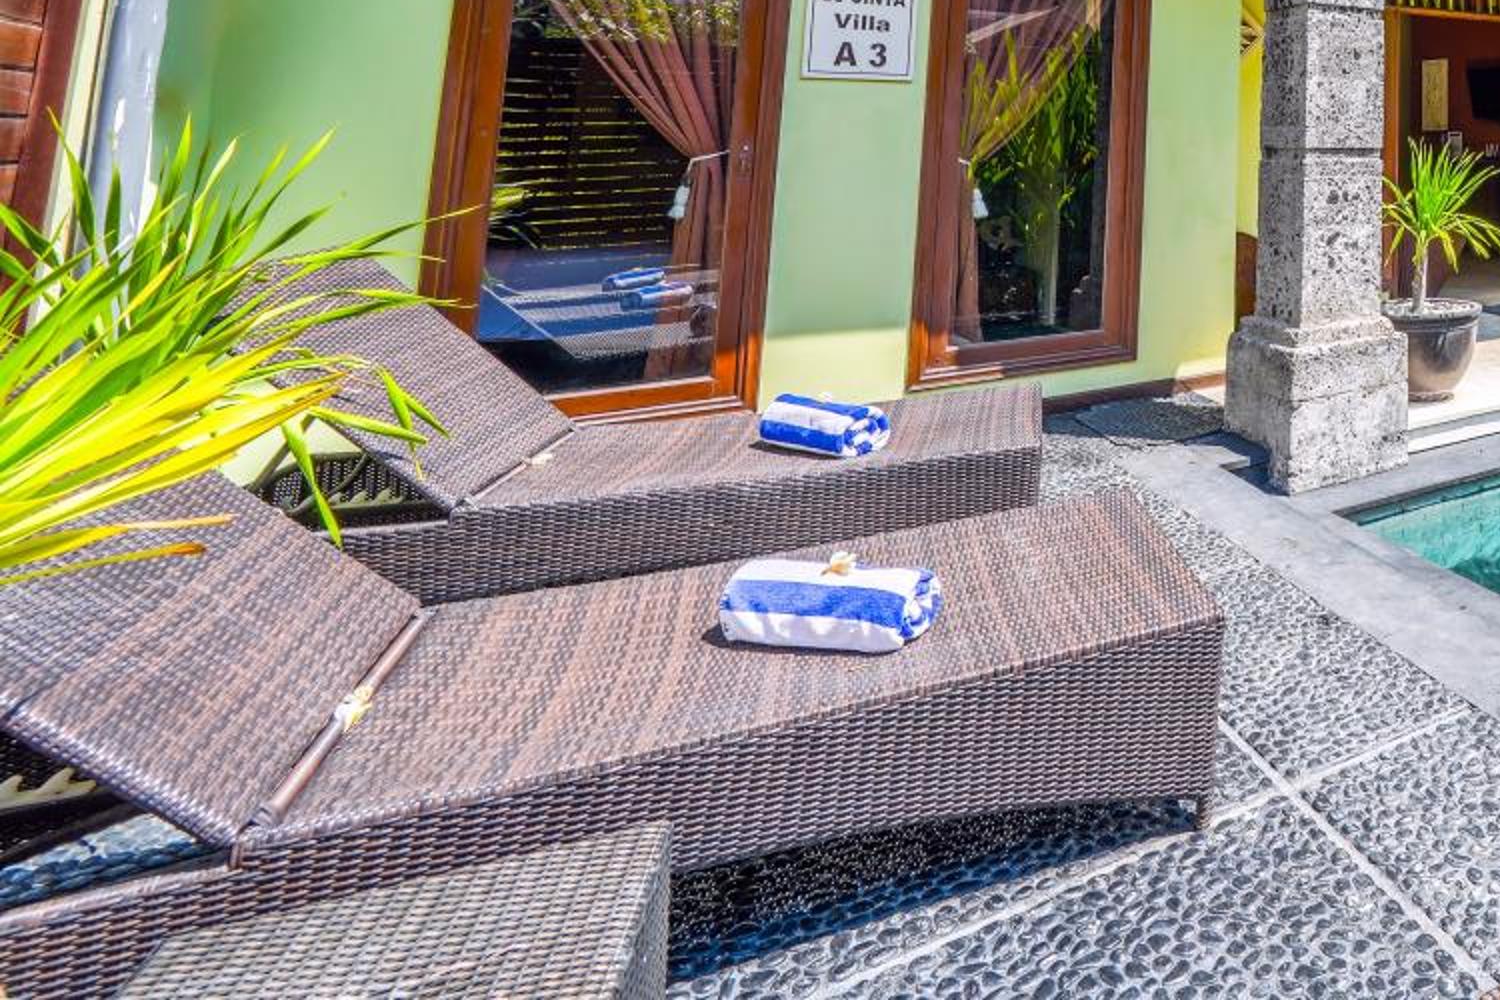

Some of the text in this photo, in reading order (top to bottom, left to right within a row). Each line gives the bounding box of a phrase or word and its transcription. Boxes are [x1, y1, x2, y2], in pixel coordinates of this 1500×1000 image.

[834, 13, 890, 32] Villa
[834, 41, 887, 67] A 3
